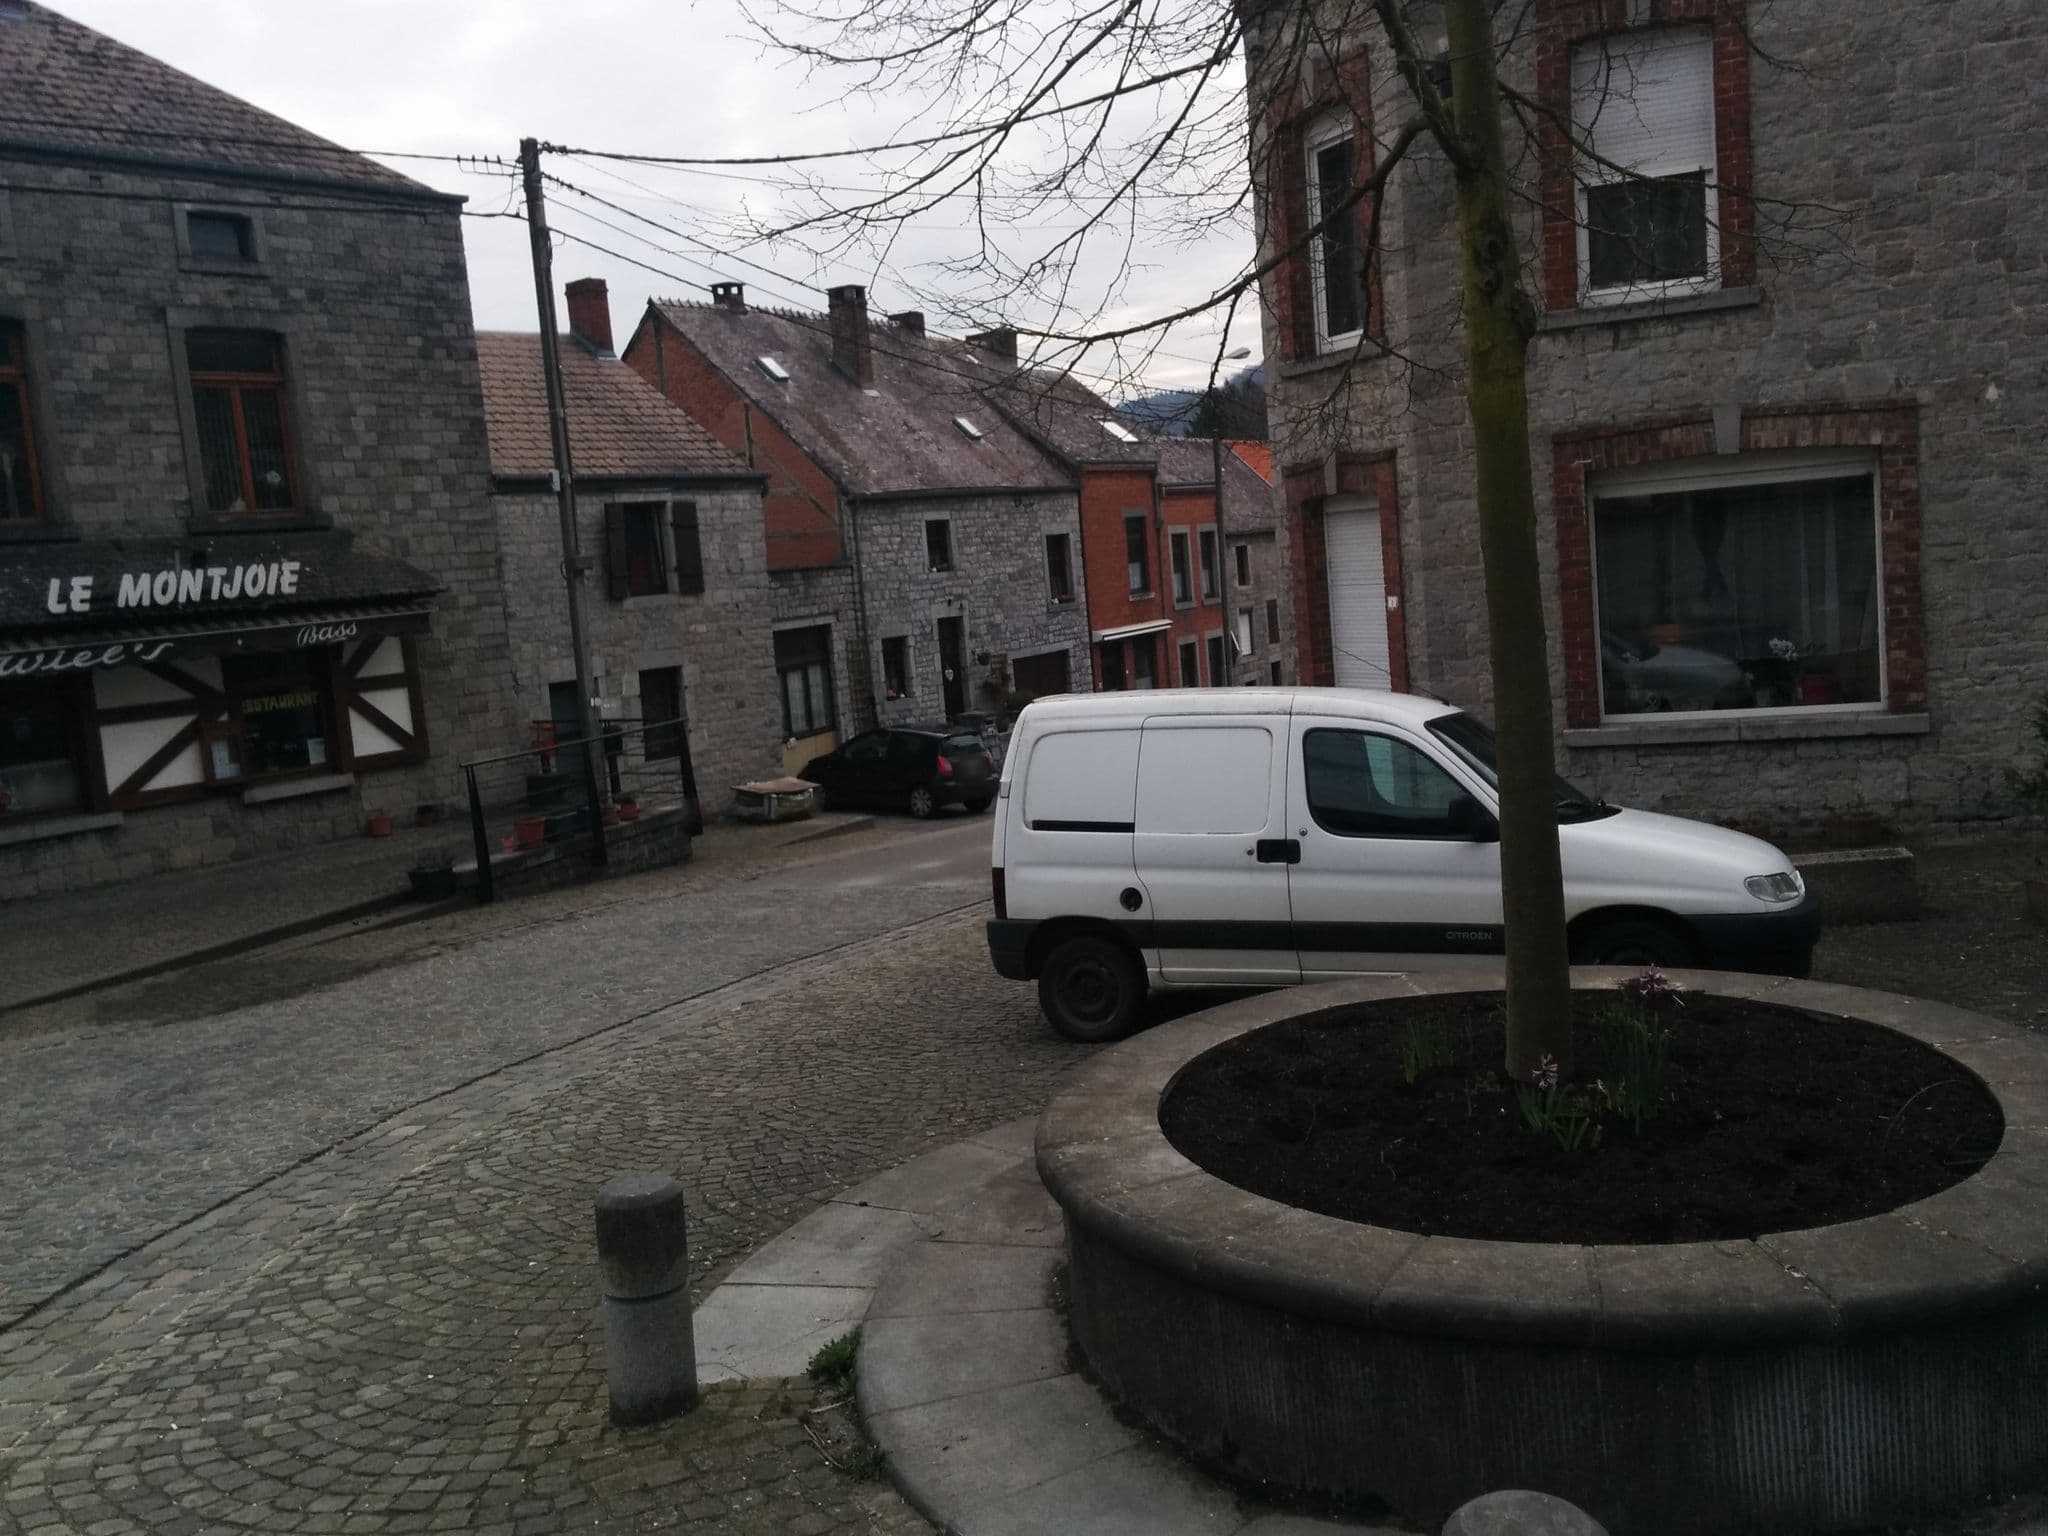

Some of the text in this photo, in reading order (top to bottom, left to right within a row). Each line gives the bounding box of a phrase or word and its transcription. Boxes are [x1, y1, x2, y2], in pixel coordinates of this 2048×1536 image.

[47, 562, 301, 614] LE MONTJOIE
[297, 621, 358, 647] Bass
